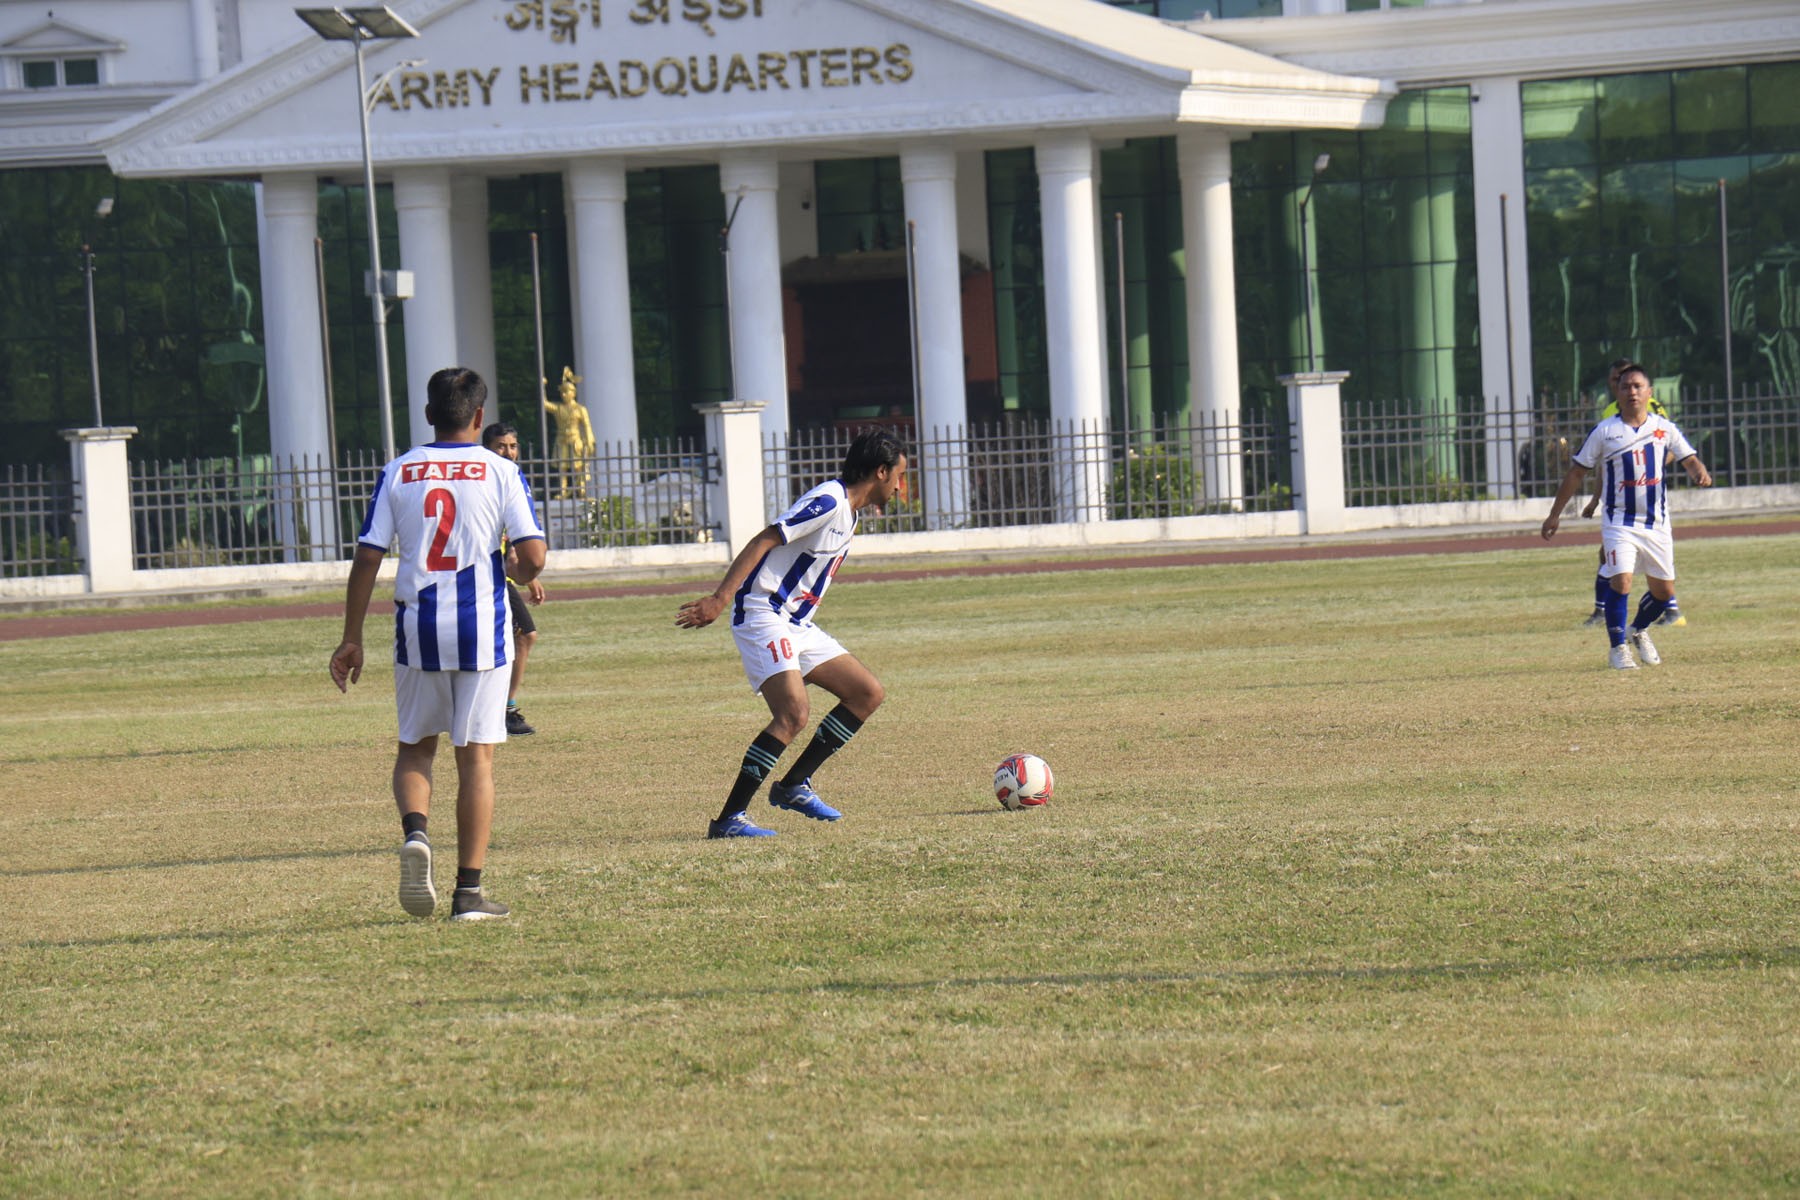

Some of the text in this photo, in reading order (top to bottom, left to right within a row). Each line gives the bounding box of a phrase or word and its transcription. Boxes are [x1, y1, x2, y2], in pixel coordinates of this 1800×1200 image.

[367, 43, 914, 112] ARMY HEADQUARTERS
[406, 464, 482, 480] TAFC
[424, 488, 457, 571] 2
[767, 638, 793, 663] 10
